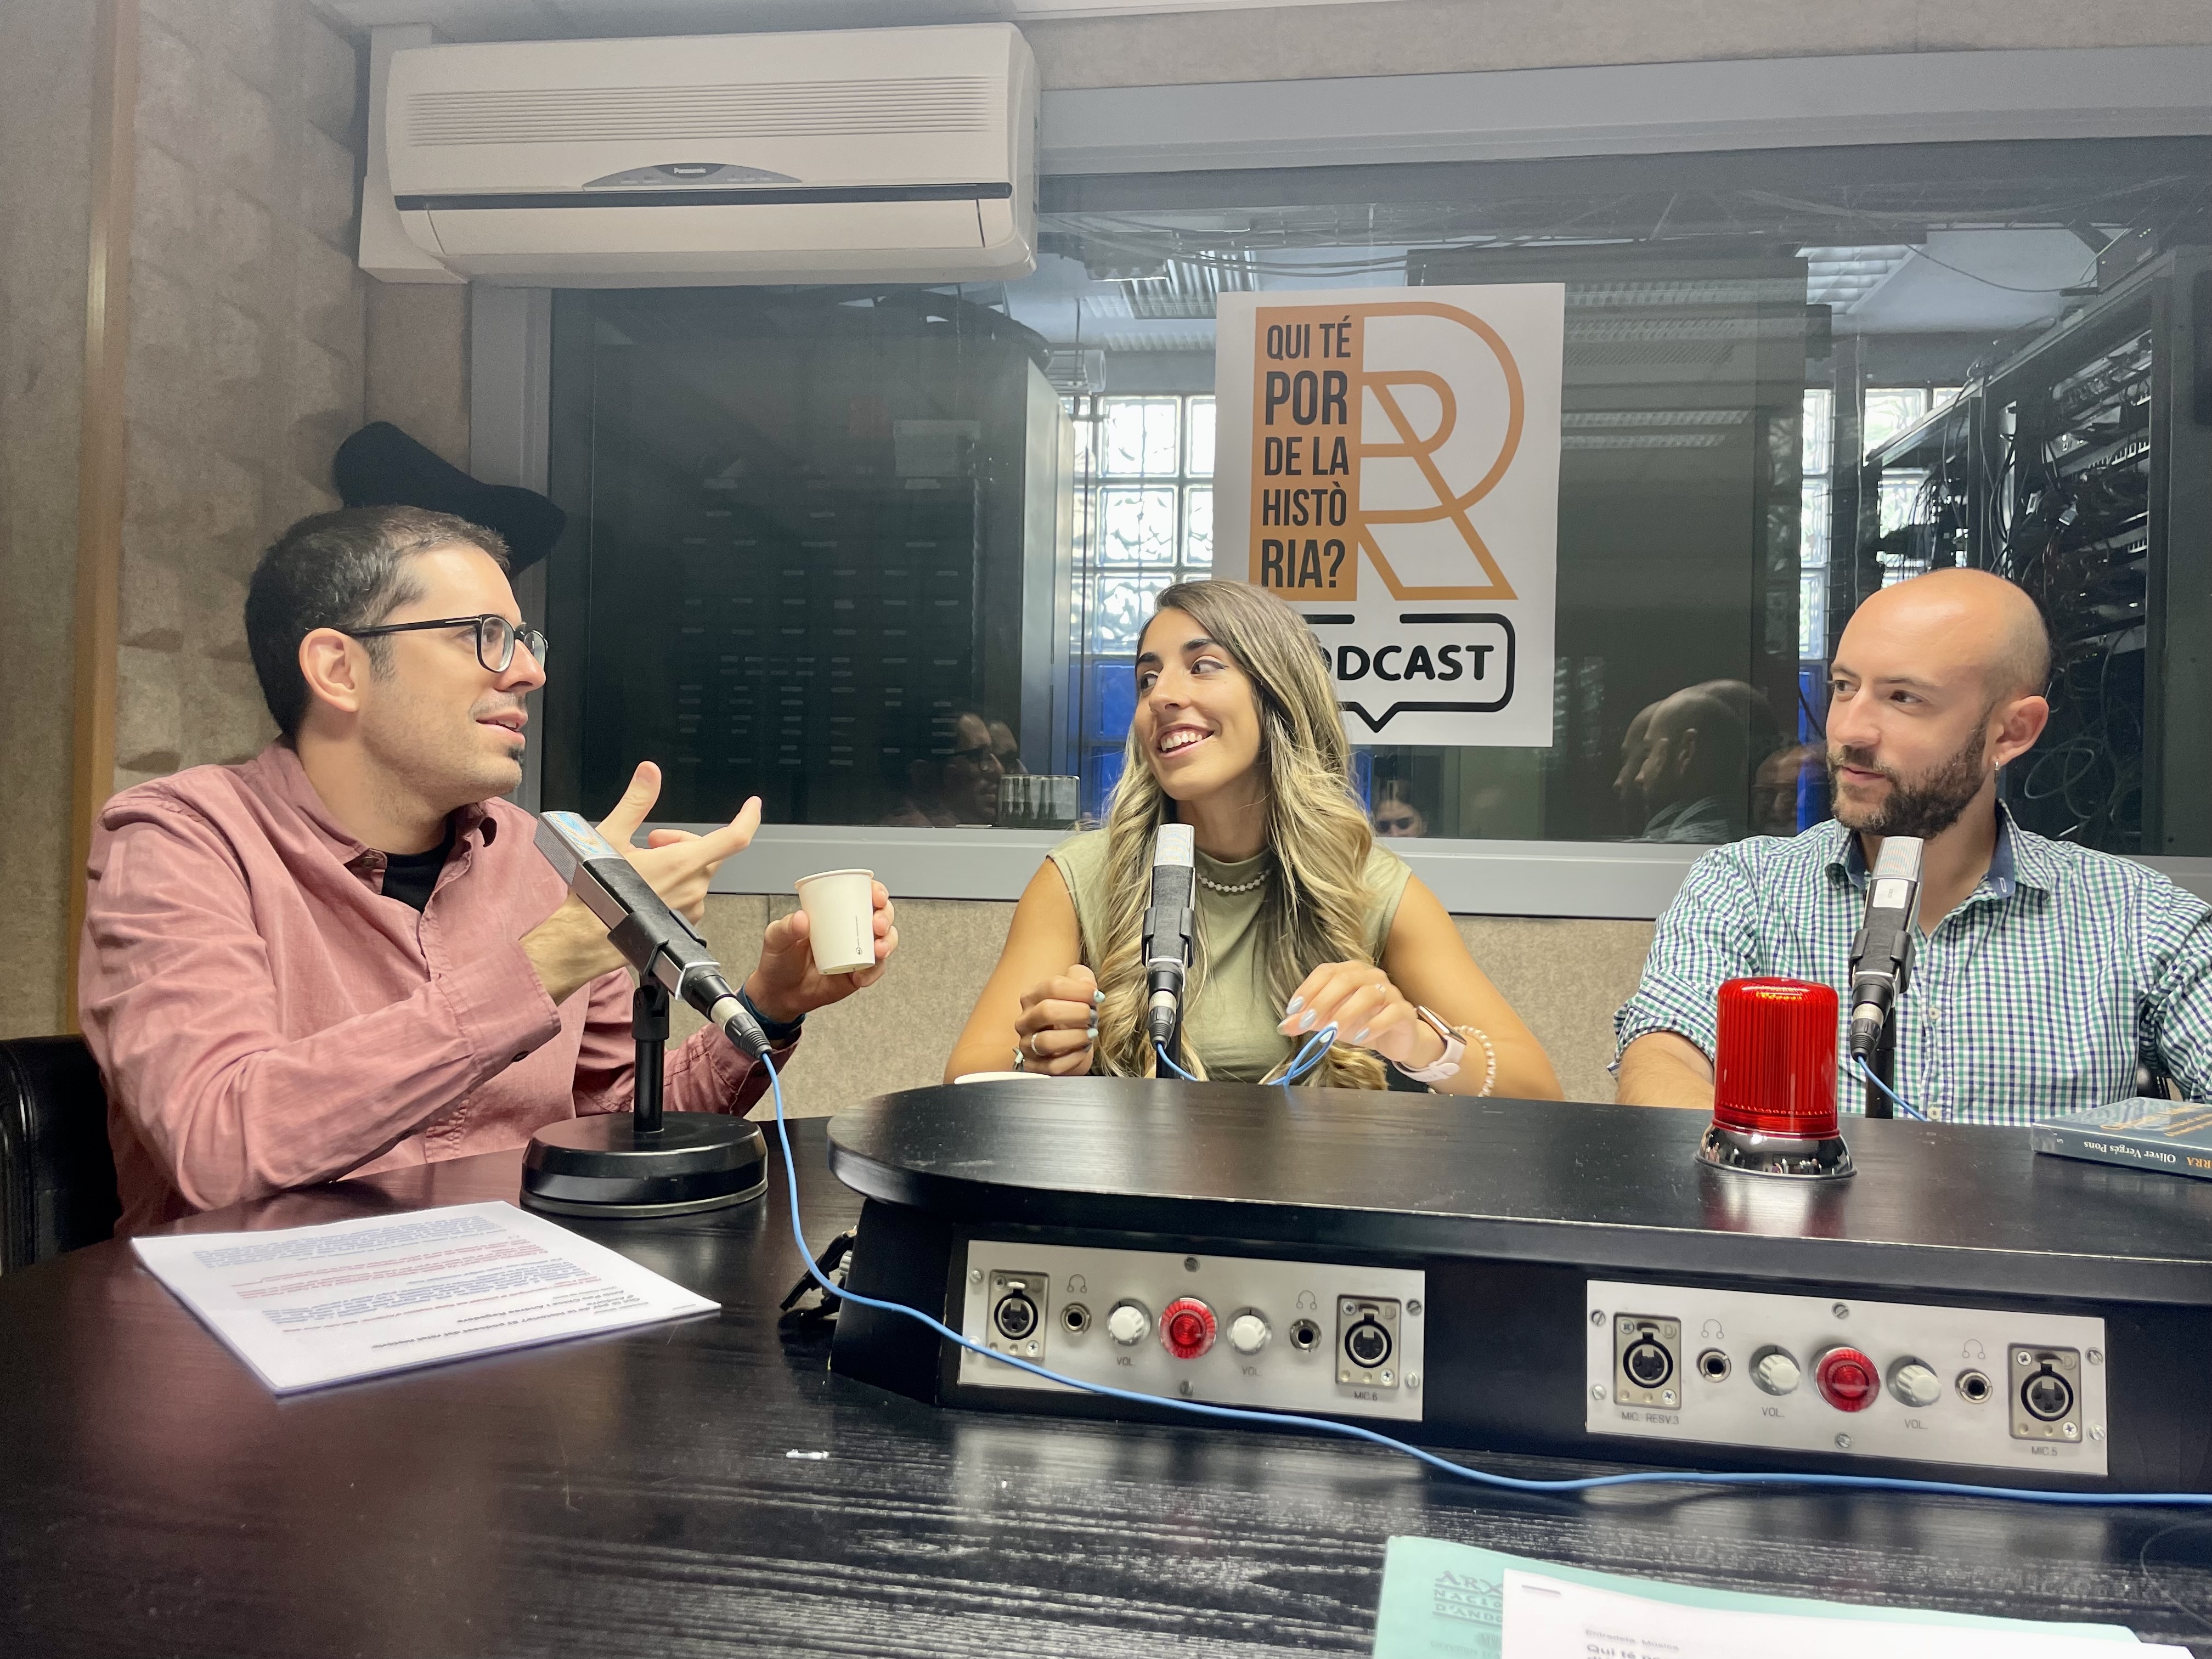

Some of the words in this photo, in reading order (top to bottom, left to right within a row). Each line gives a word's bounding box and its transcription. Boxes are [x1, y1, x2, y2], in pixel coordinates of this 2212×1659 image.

[1267, 324, 1310, 360] QUI
[1319, 315, 1352, 358] TÉ
[1265, 370, 1348, 426] POR
[1265, 437, 1301, 476] DE
[1312, 436, 1349, 476] LA
[1262, 482, 1347, 527] HISTÒ
[1261, 539, 1345, 588] RIA?
[1320, 645, 1494, 681] DCAST
[2084, 1141, 2107, 1153] Pons
[2144, 1150, 2176, 1163] Oliver
[2186, 1156, 2212, 1169] RRA
[1435, 1570, 1503, 1595] ARX
[1434, 1589, 1502, 1608] NACIO
[1434, 1604, 1503, 1623] D'ANDO
[1587, 1644, 1615, 1656] Qui
